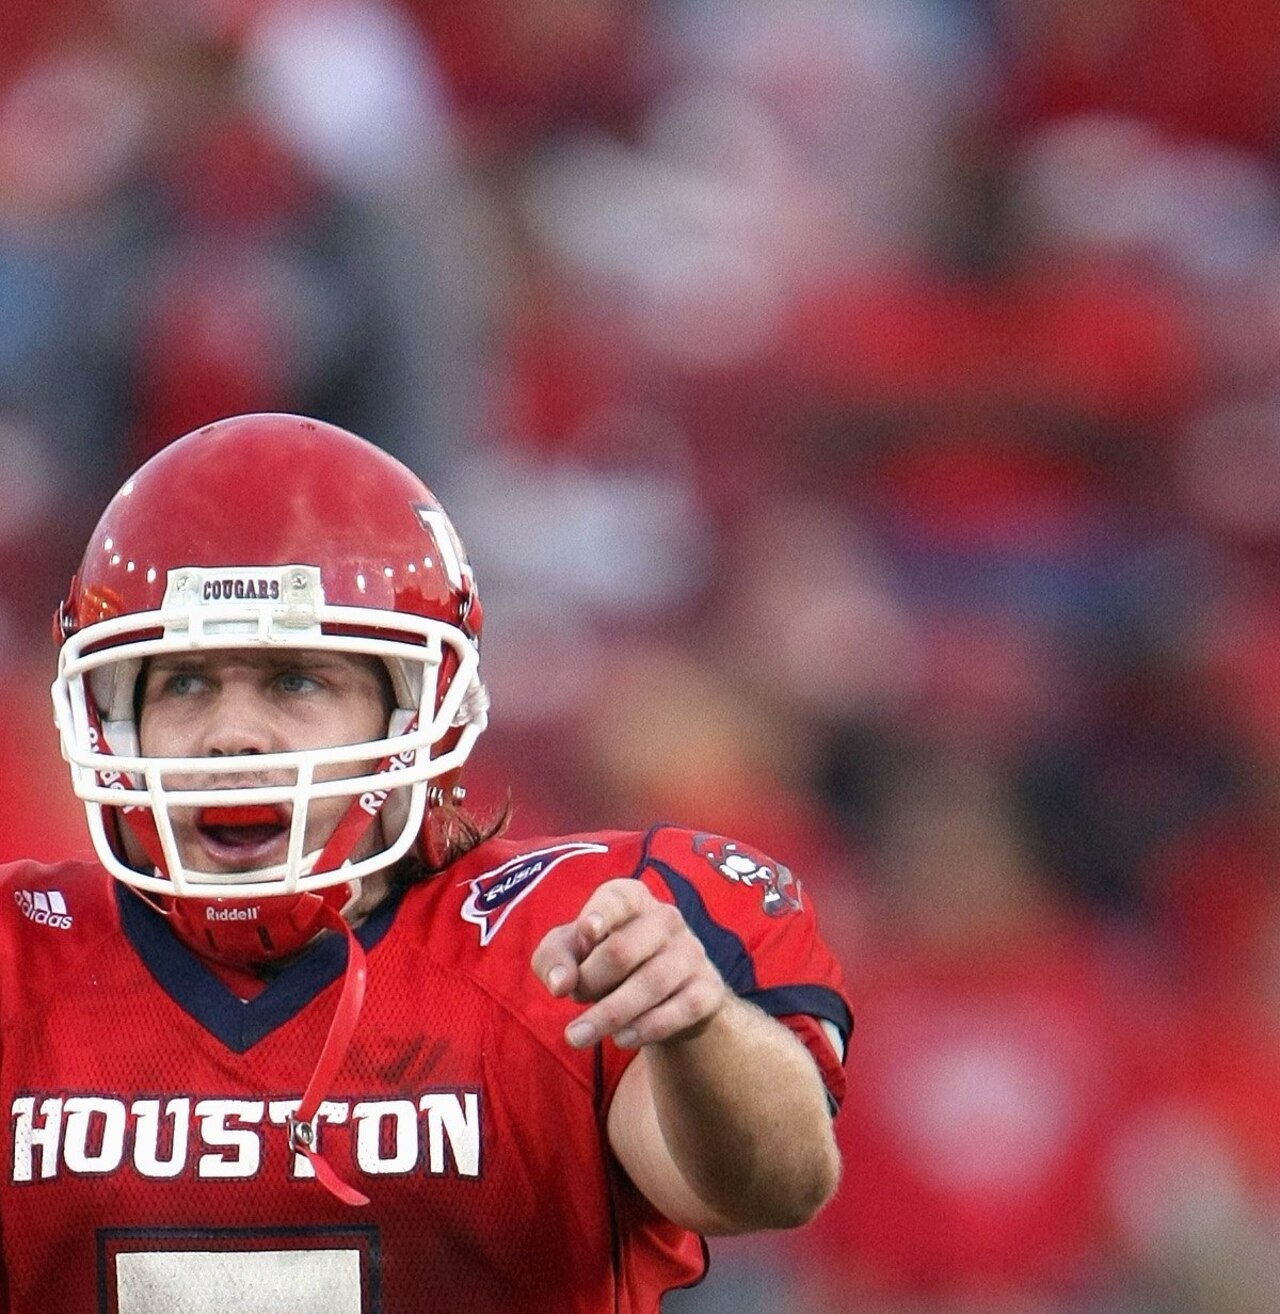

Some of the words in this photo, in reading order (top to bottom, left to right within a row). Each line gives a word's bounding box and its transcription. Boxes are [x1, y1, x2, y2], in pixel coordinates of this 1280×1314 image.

[203, 579, 280, 600] COUGARS
[206, 906, 258, 921] Riddell
[10, 1092, 480, 1182] HOUSTON
